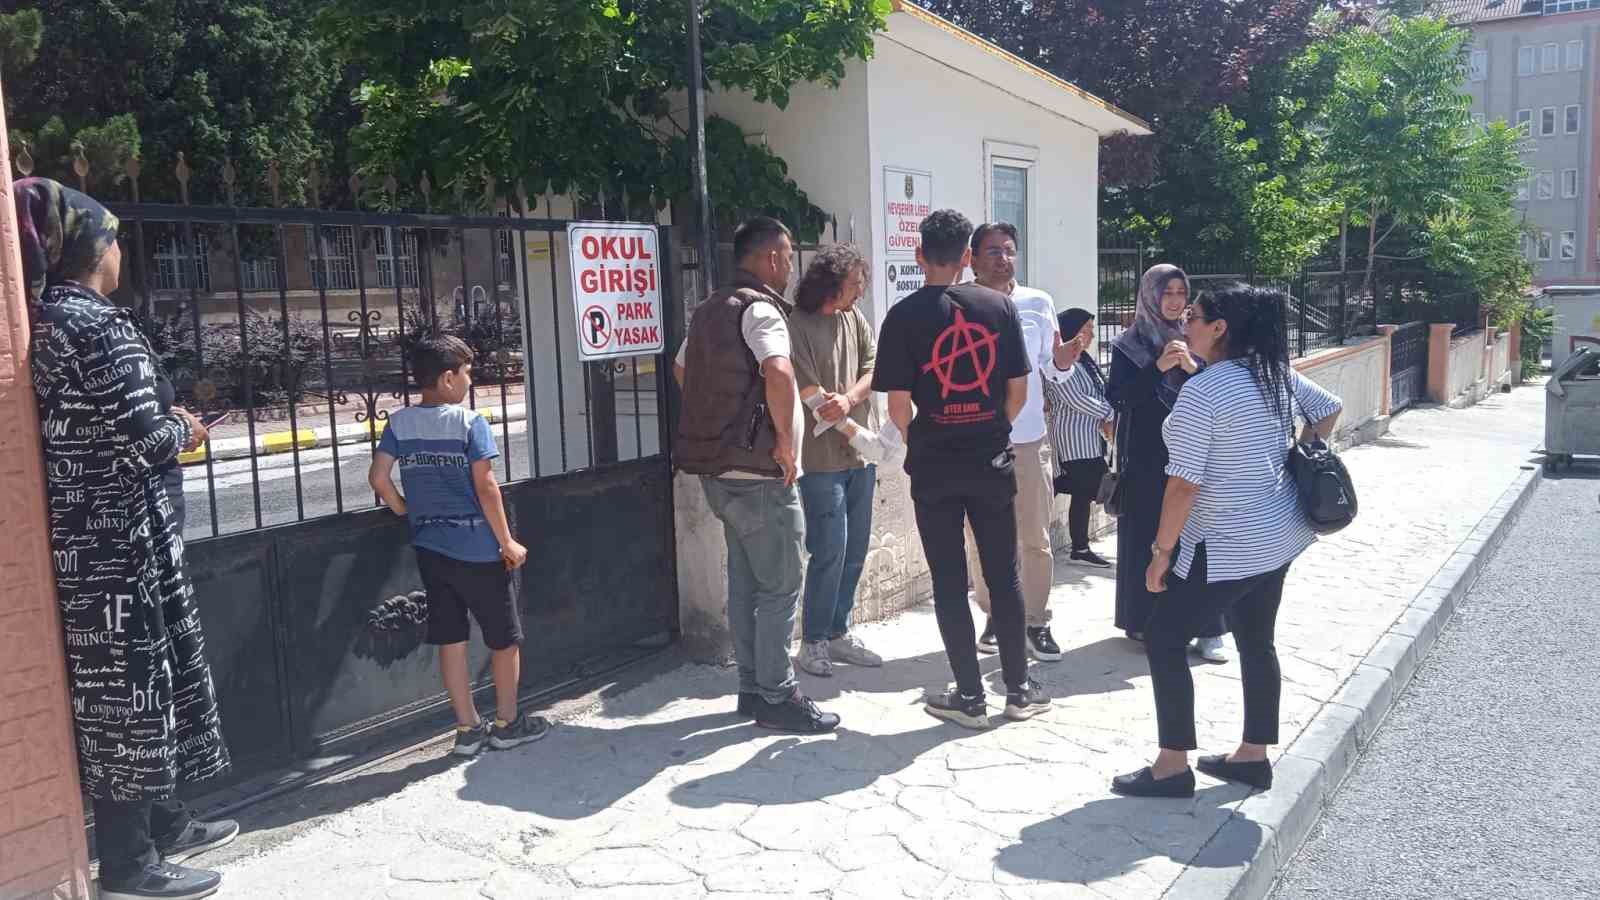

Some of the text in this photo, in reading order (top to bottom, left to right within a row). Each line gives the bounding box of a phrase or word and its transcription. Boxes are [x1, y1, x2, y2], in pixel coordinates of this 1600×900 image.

[899, 219, 921, 232] ÖZEL
[581, 235, 652, 260] OKUL
[580, 263, 656, 298] GİRİŞİ
[616, 302, 653, 321] PARK
[613, 326, 659, 346] YASAK
